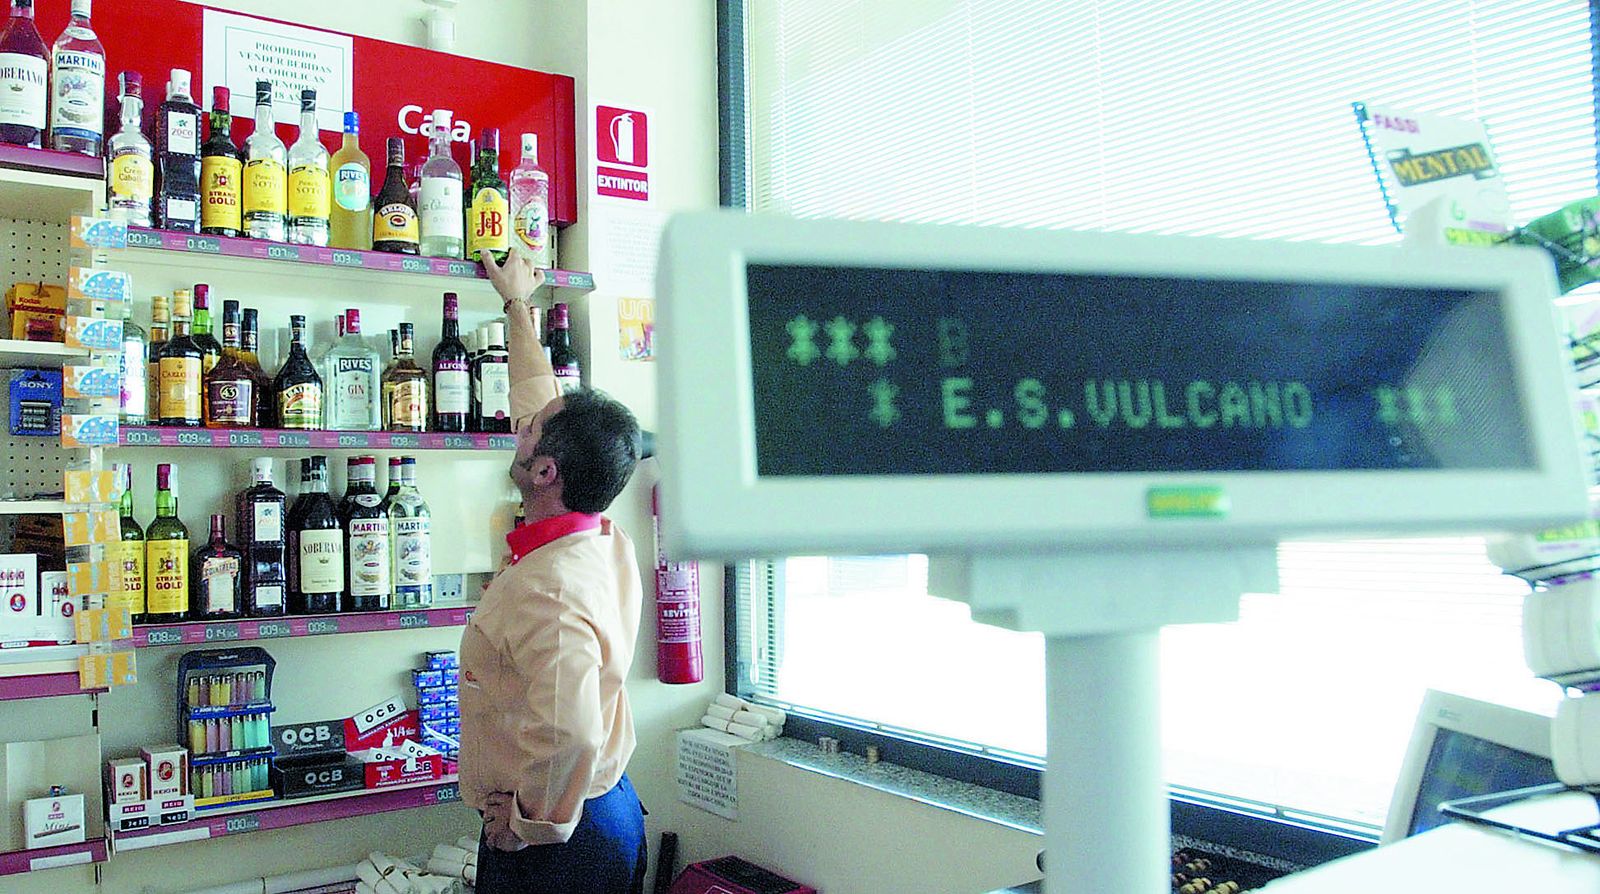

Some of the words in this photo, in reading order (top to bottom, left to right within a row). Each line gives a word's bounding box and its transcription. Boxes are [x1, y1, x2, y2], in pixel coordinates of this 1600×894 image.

[255, 42, 317, 59] PROHIBIDO
[57, 55, 101, 71] MARTINI
[239, 51, 284, 65] VENDER
[287, 59, 332, 74] BEBIDAS
[247, 64, 326, 84] ALCOHOLICAS
[397, 105, 471, 143] Caa
[1393, 146, 1490, 183] MENTAL
[598, 175, 648, 193] EXTINTOR
[209, 197, 236, 206] GOLD
[476, 211, 503, 237] J&B
[341, 359, 372, 370] RIVES
[19, 381, 54, 389] SONY
[347, 384, 365, 395] GIN
[155, 581, 184, 591] GOLD
[365, 703, 396, 723] OCB
[281, 725, 331, 745] OCB
[305, 769, 343, 785] OCB
